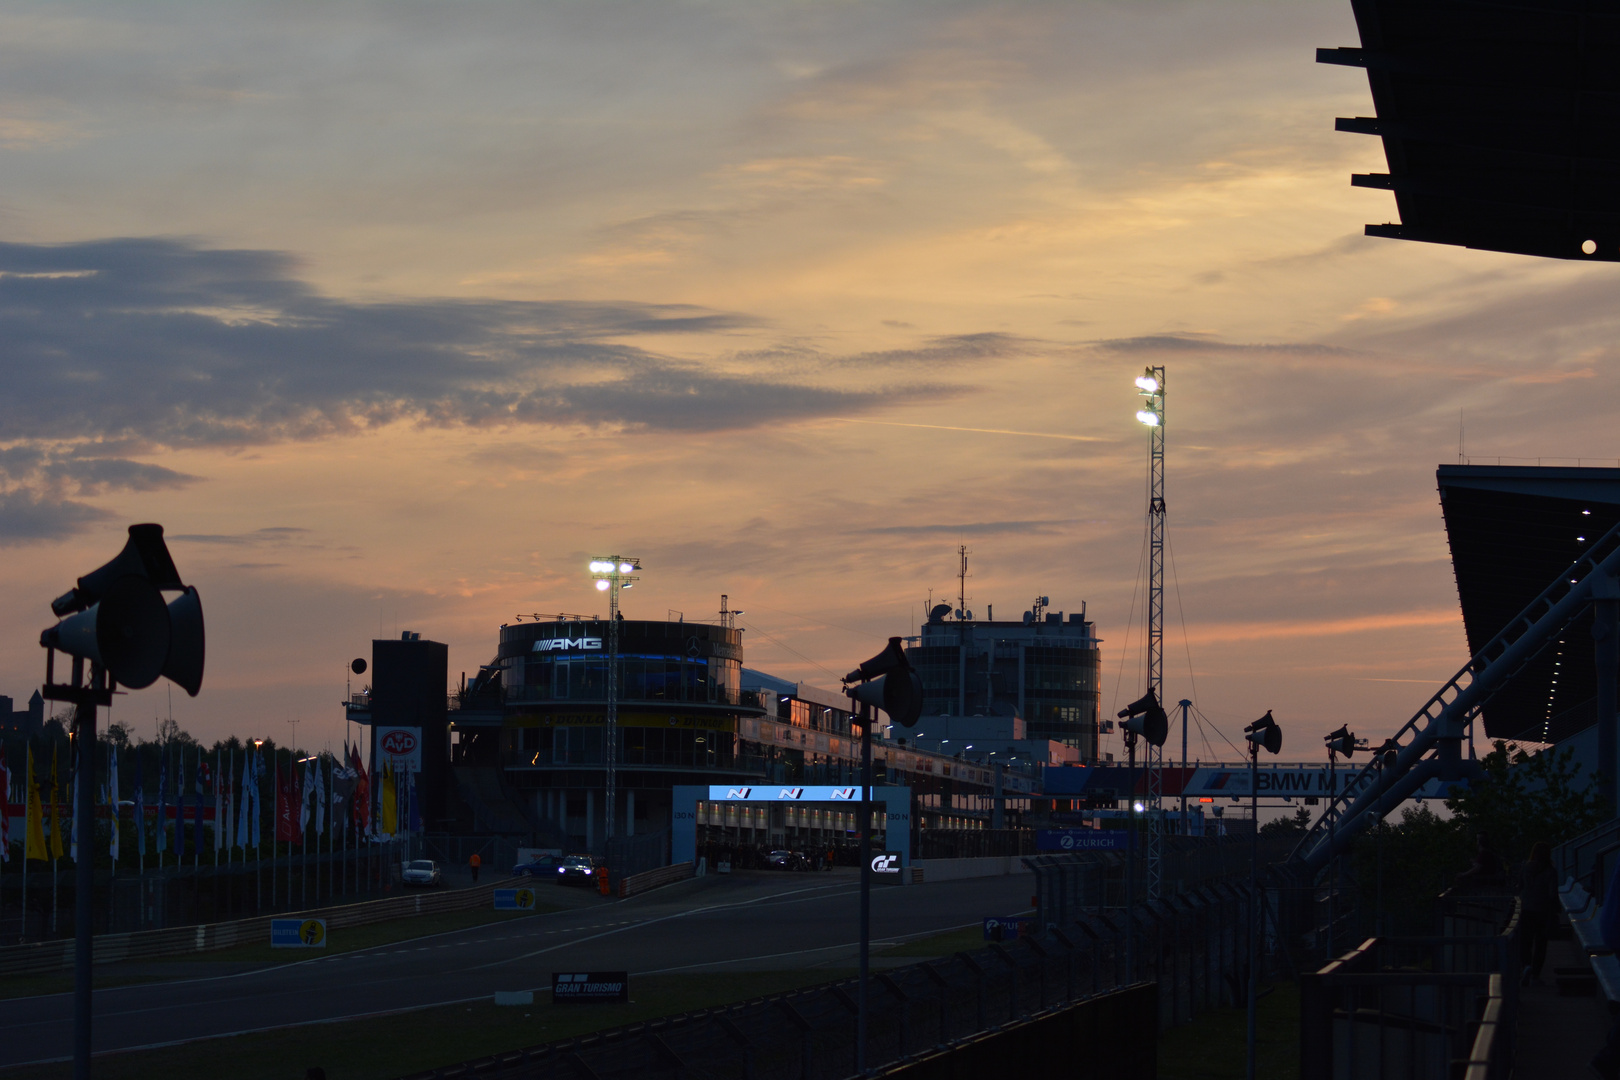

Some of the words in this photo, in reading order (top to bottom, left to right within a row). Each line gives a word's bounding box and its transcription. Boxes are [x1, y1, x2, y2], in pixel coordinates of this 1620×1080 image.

[550, 638, 602, 651] AMG
[1256, 773, 1312, 791] BMW
[1076, 839, 1115, 847] ZURICH
[555, 983, 581, 993] GRAN
[582, 982, 623, 992] TURISMO
